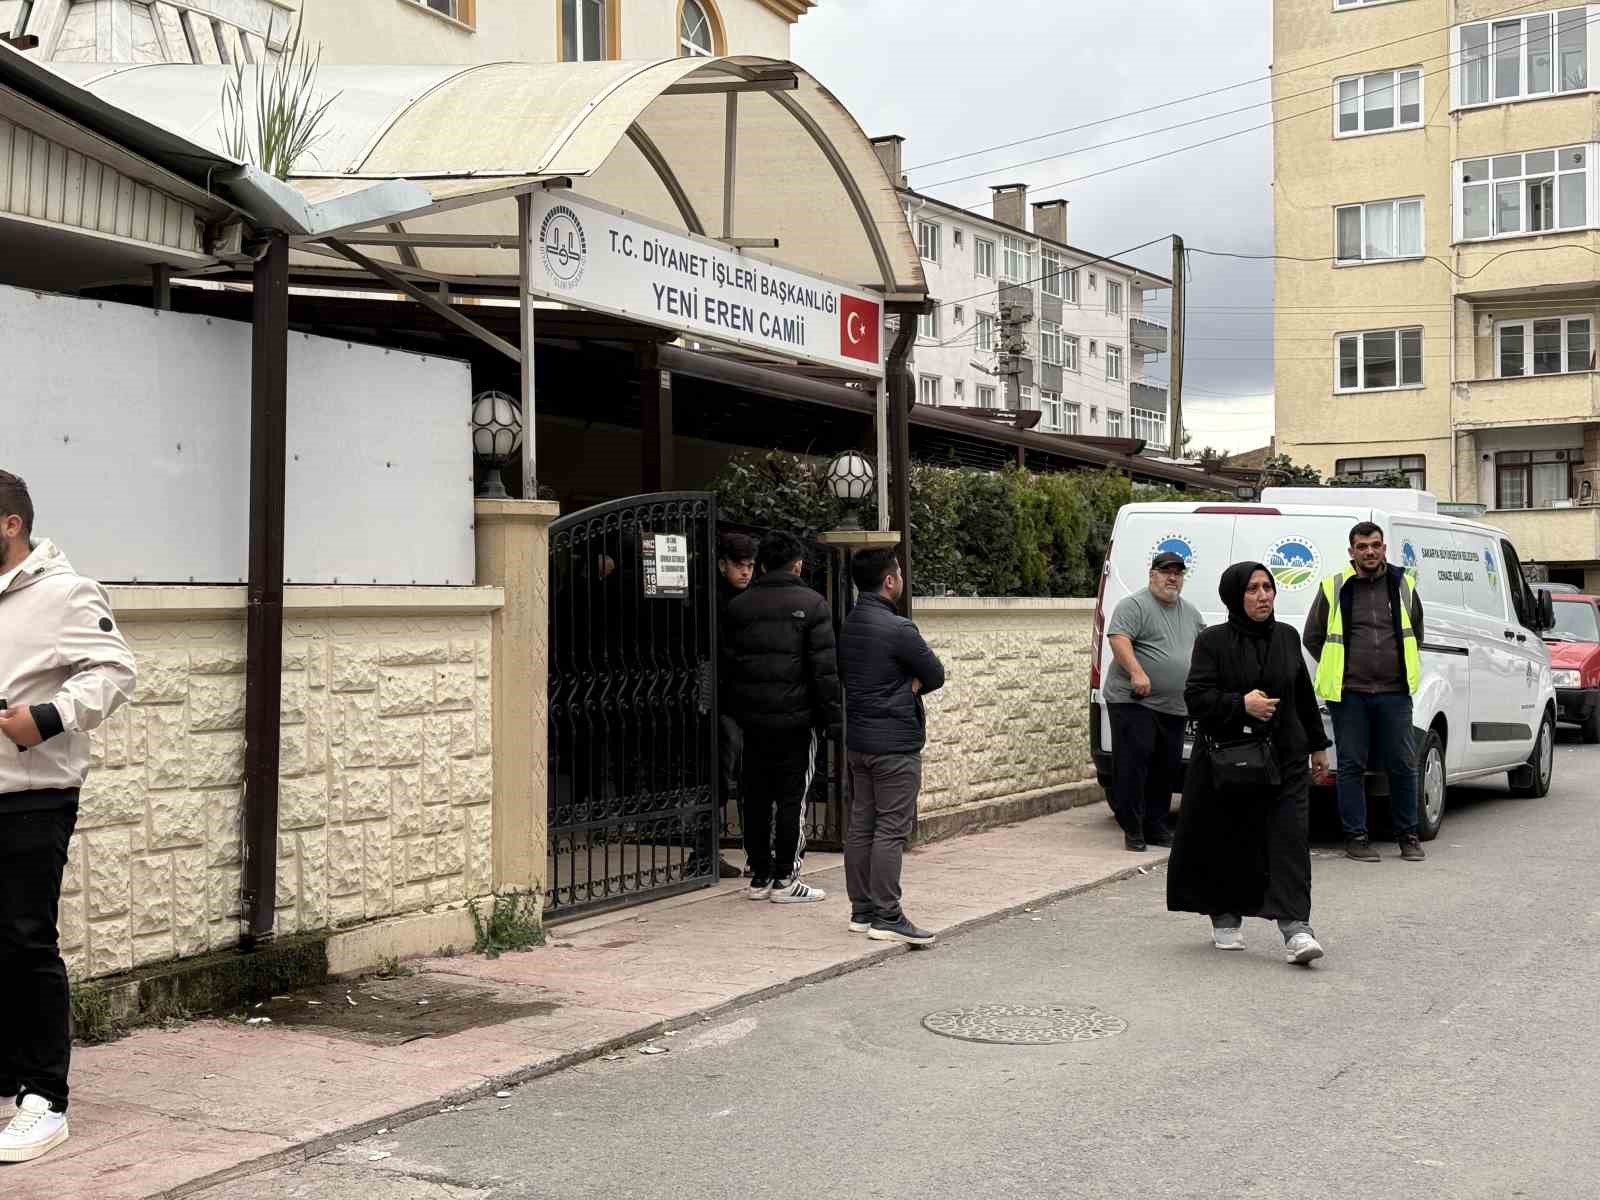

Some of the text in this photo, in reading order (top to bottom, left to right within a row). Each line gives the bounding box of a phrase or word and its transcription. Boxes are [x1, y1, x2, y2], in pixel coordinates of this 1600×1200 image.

[609, 229, 837, 315] T.C. DİYANET İŞLERİ BAŞKANLIĞI
[652, 282, 805, 346] YENİ EREN CAMİİ
